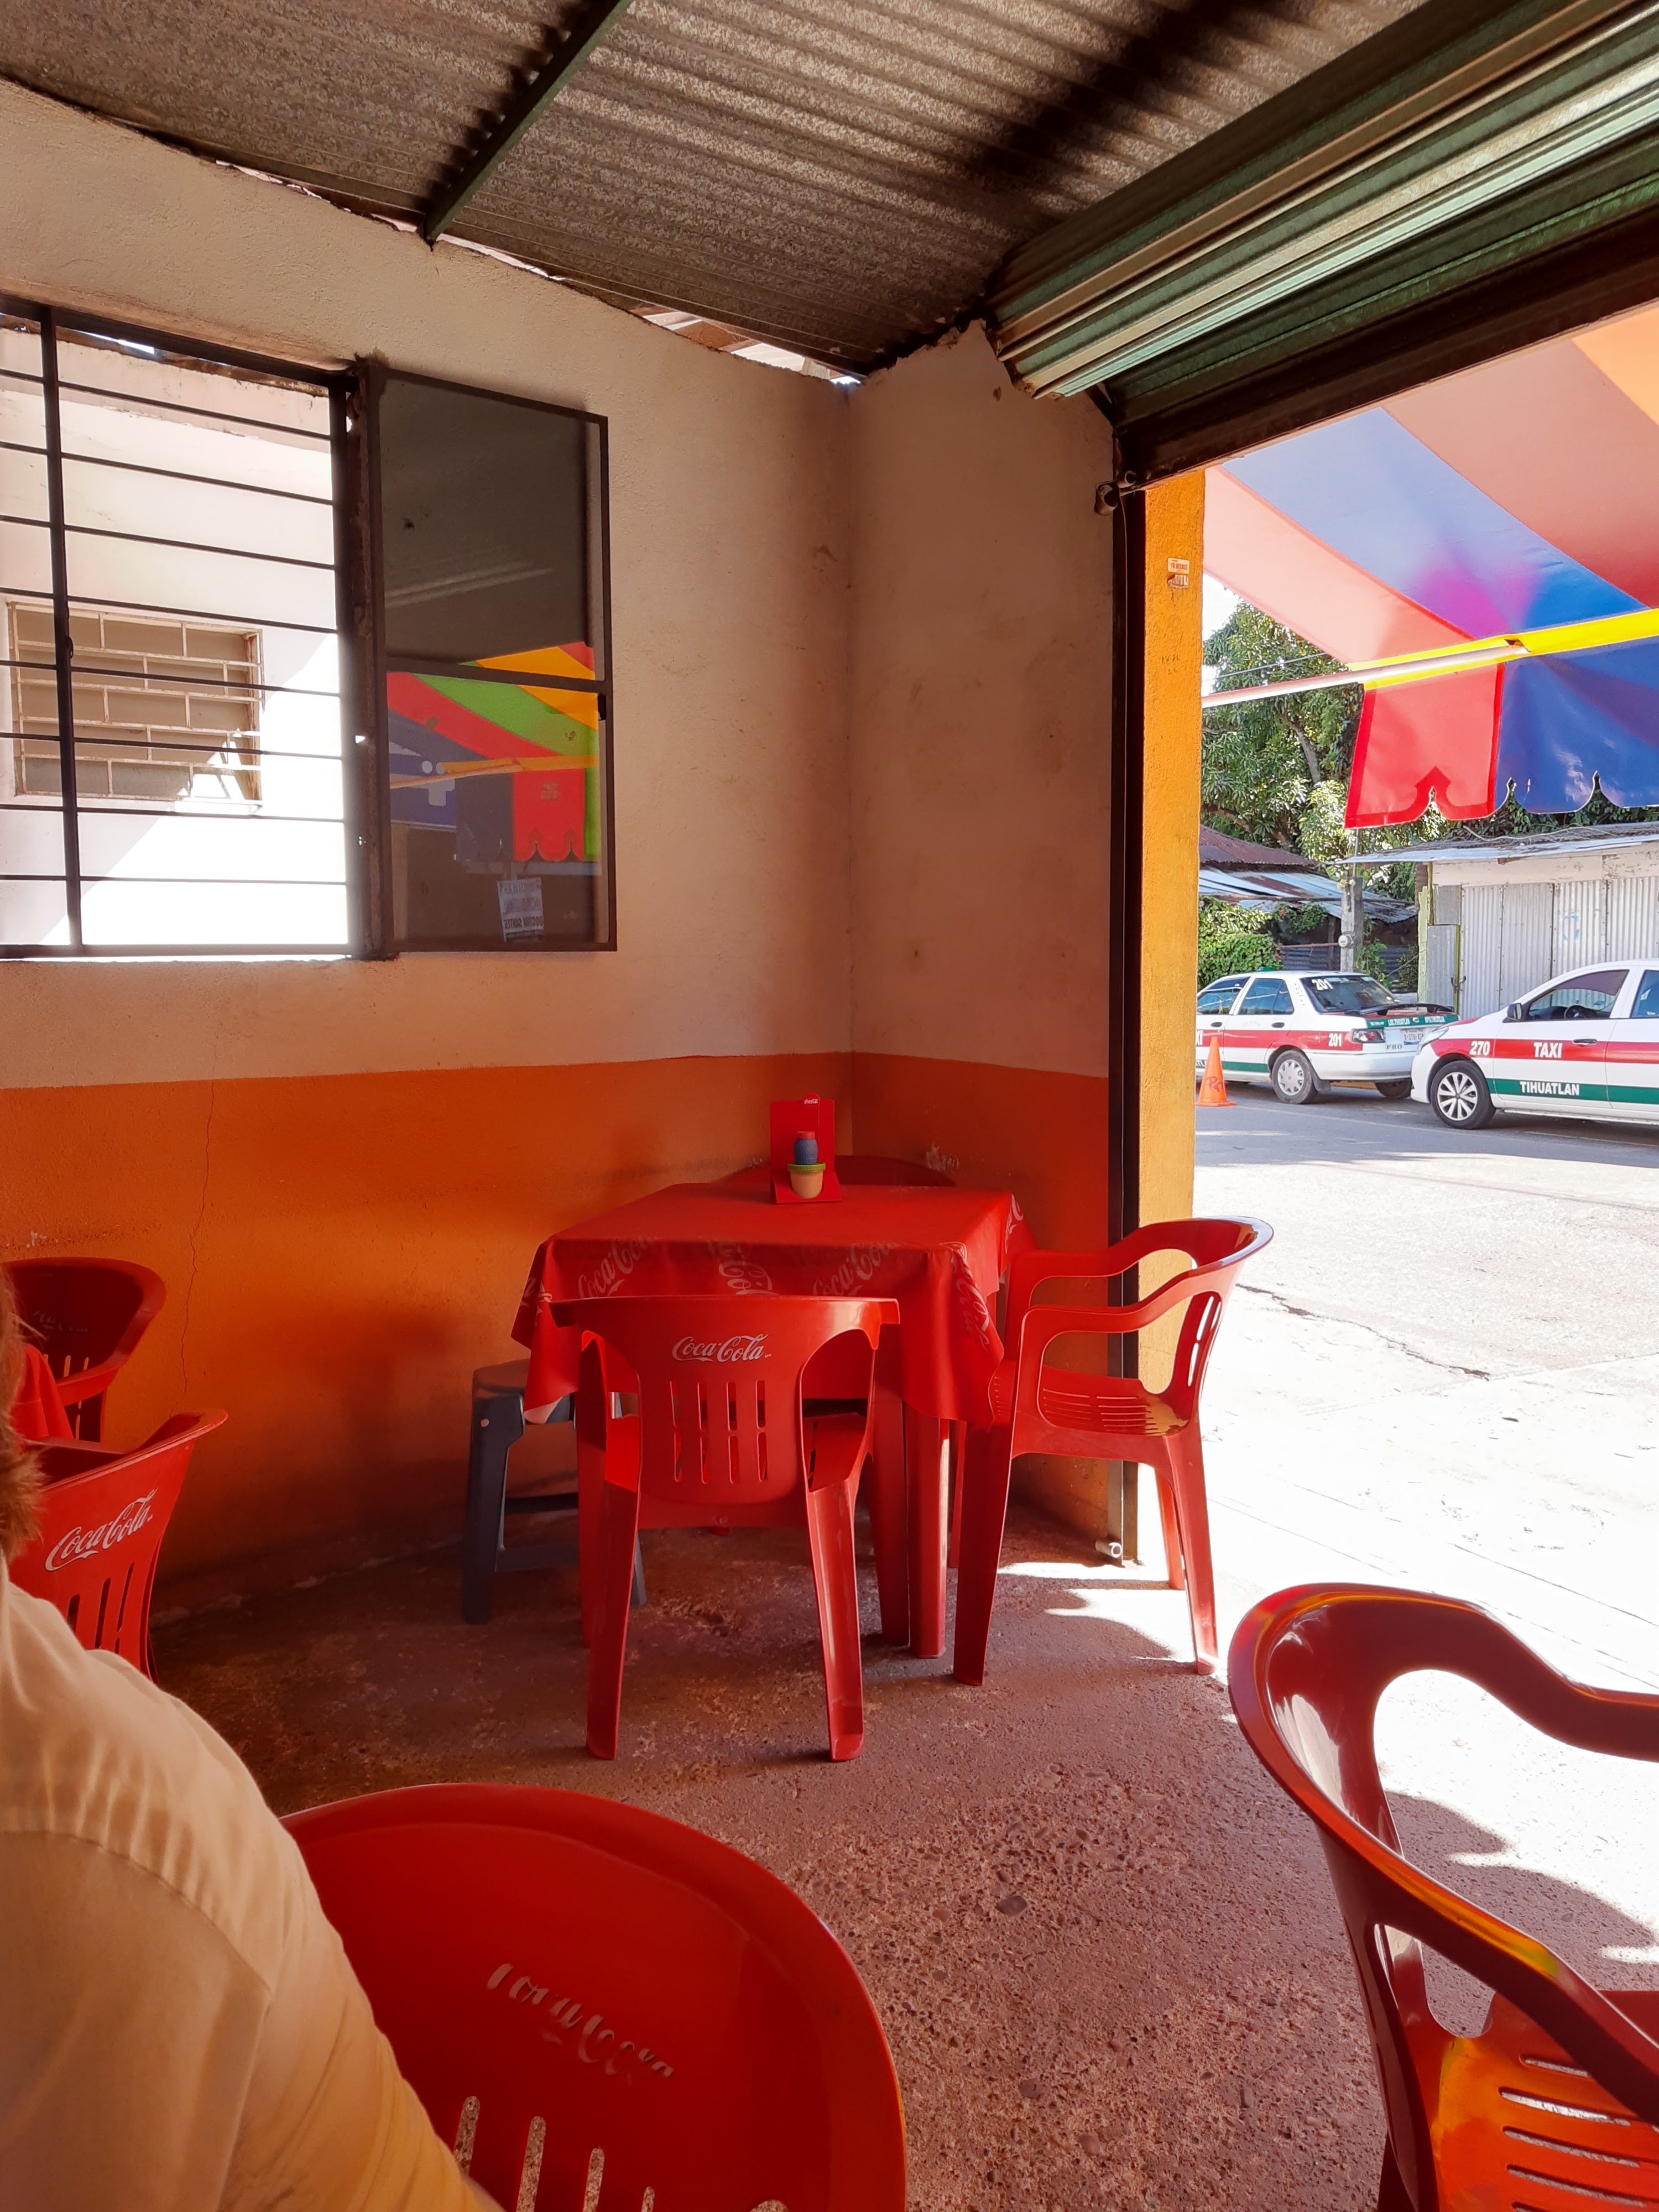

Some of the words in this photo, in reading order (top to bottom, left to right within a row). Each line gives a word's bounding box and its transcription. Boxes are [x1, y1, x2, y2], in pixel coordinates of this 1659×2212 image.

[1312, 978, 1333, 990] 201
[1328, 1033, 1342, 1047] 201
[1469, 1041, 1490, 1056] 270
[1533, 1042, 1563, 1058] TAXI
[1520, 1081, 1580, 1095] TIHUATLAN
[672, 1334, 769, 1363] Coca-Cola
[45, 1487, 158, 1571] Coca-Cola
